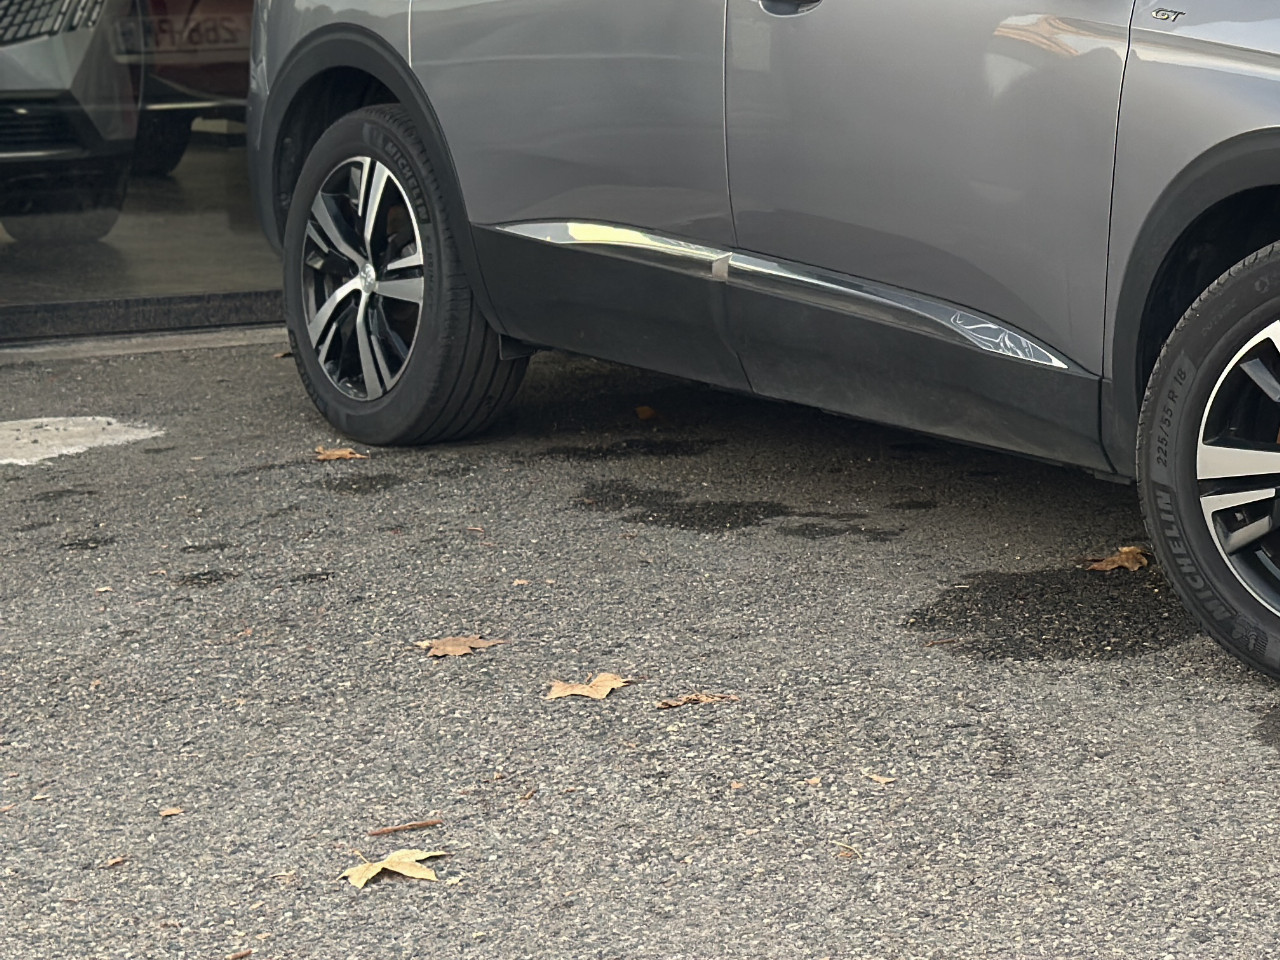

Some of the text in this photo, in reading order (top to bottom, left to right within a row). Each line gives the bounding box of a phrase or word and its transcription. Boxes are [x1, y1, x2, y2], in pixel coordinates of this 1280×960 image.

[1151, 8, 1187, 22] GT
[384, 141, 429, 222] MICHELIN
[1156, 367, 1187, 468] 225/55 R 18
[1155, 489, 1232, 622] MICHELIN
